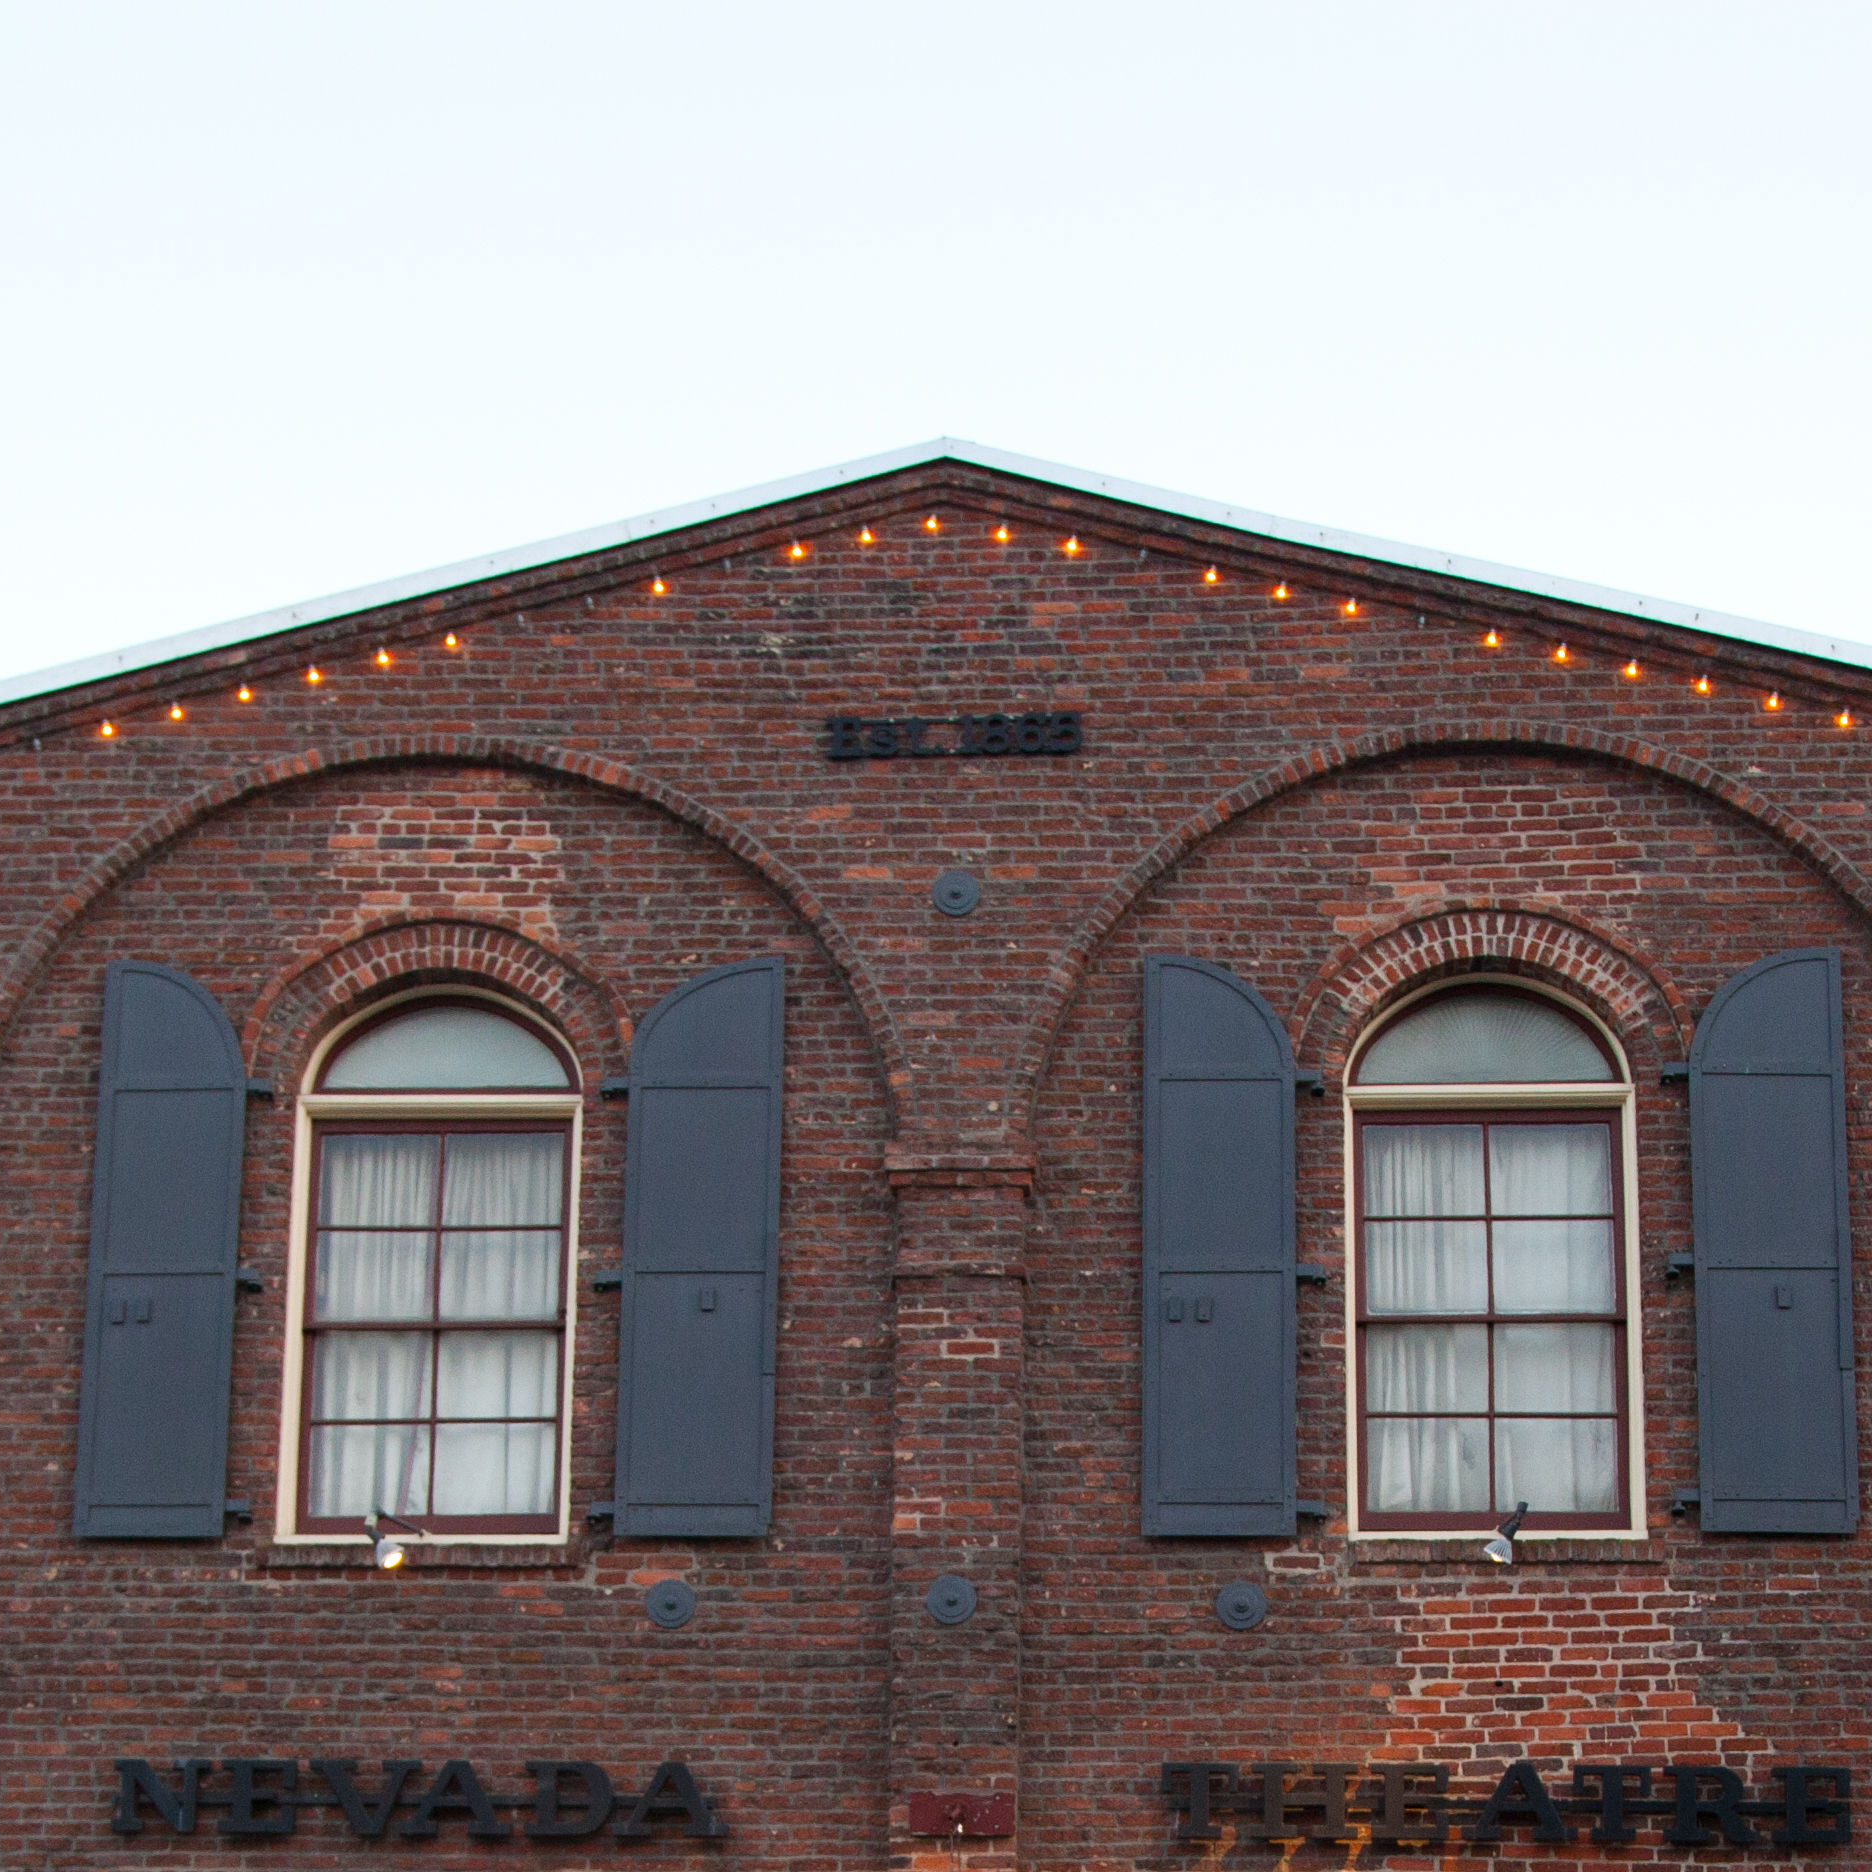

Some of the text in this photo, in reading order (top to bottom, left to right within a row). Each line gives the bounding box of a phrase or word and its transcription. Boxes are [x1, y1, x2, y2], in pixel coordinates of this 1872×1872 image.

[958, 711, 1082, 755] 1865
[111, 1758, 1853, 1843] NEVADA THEATRE
